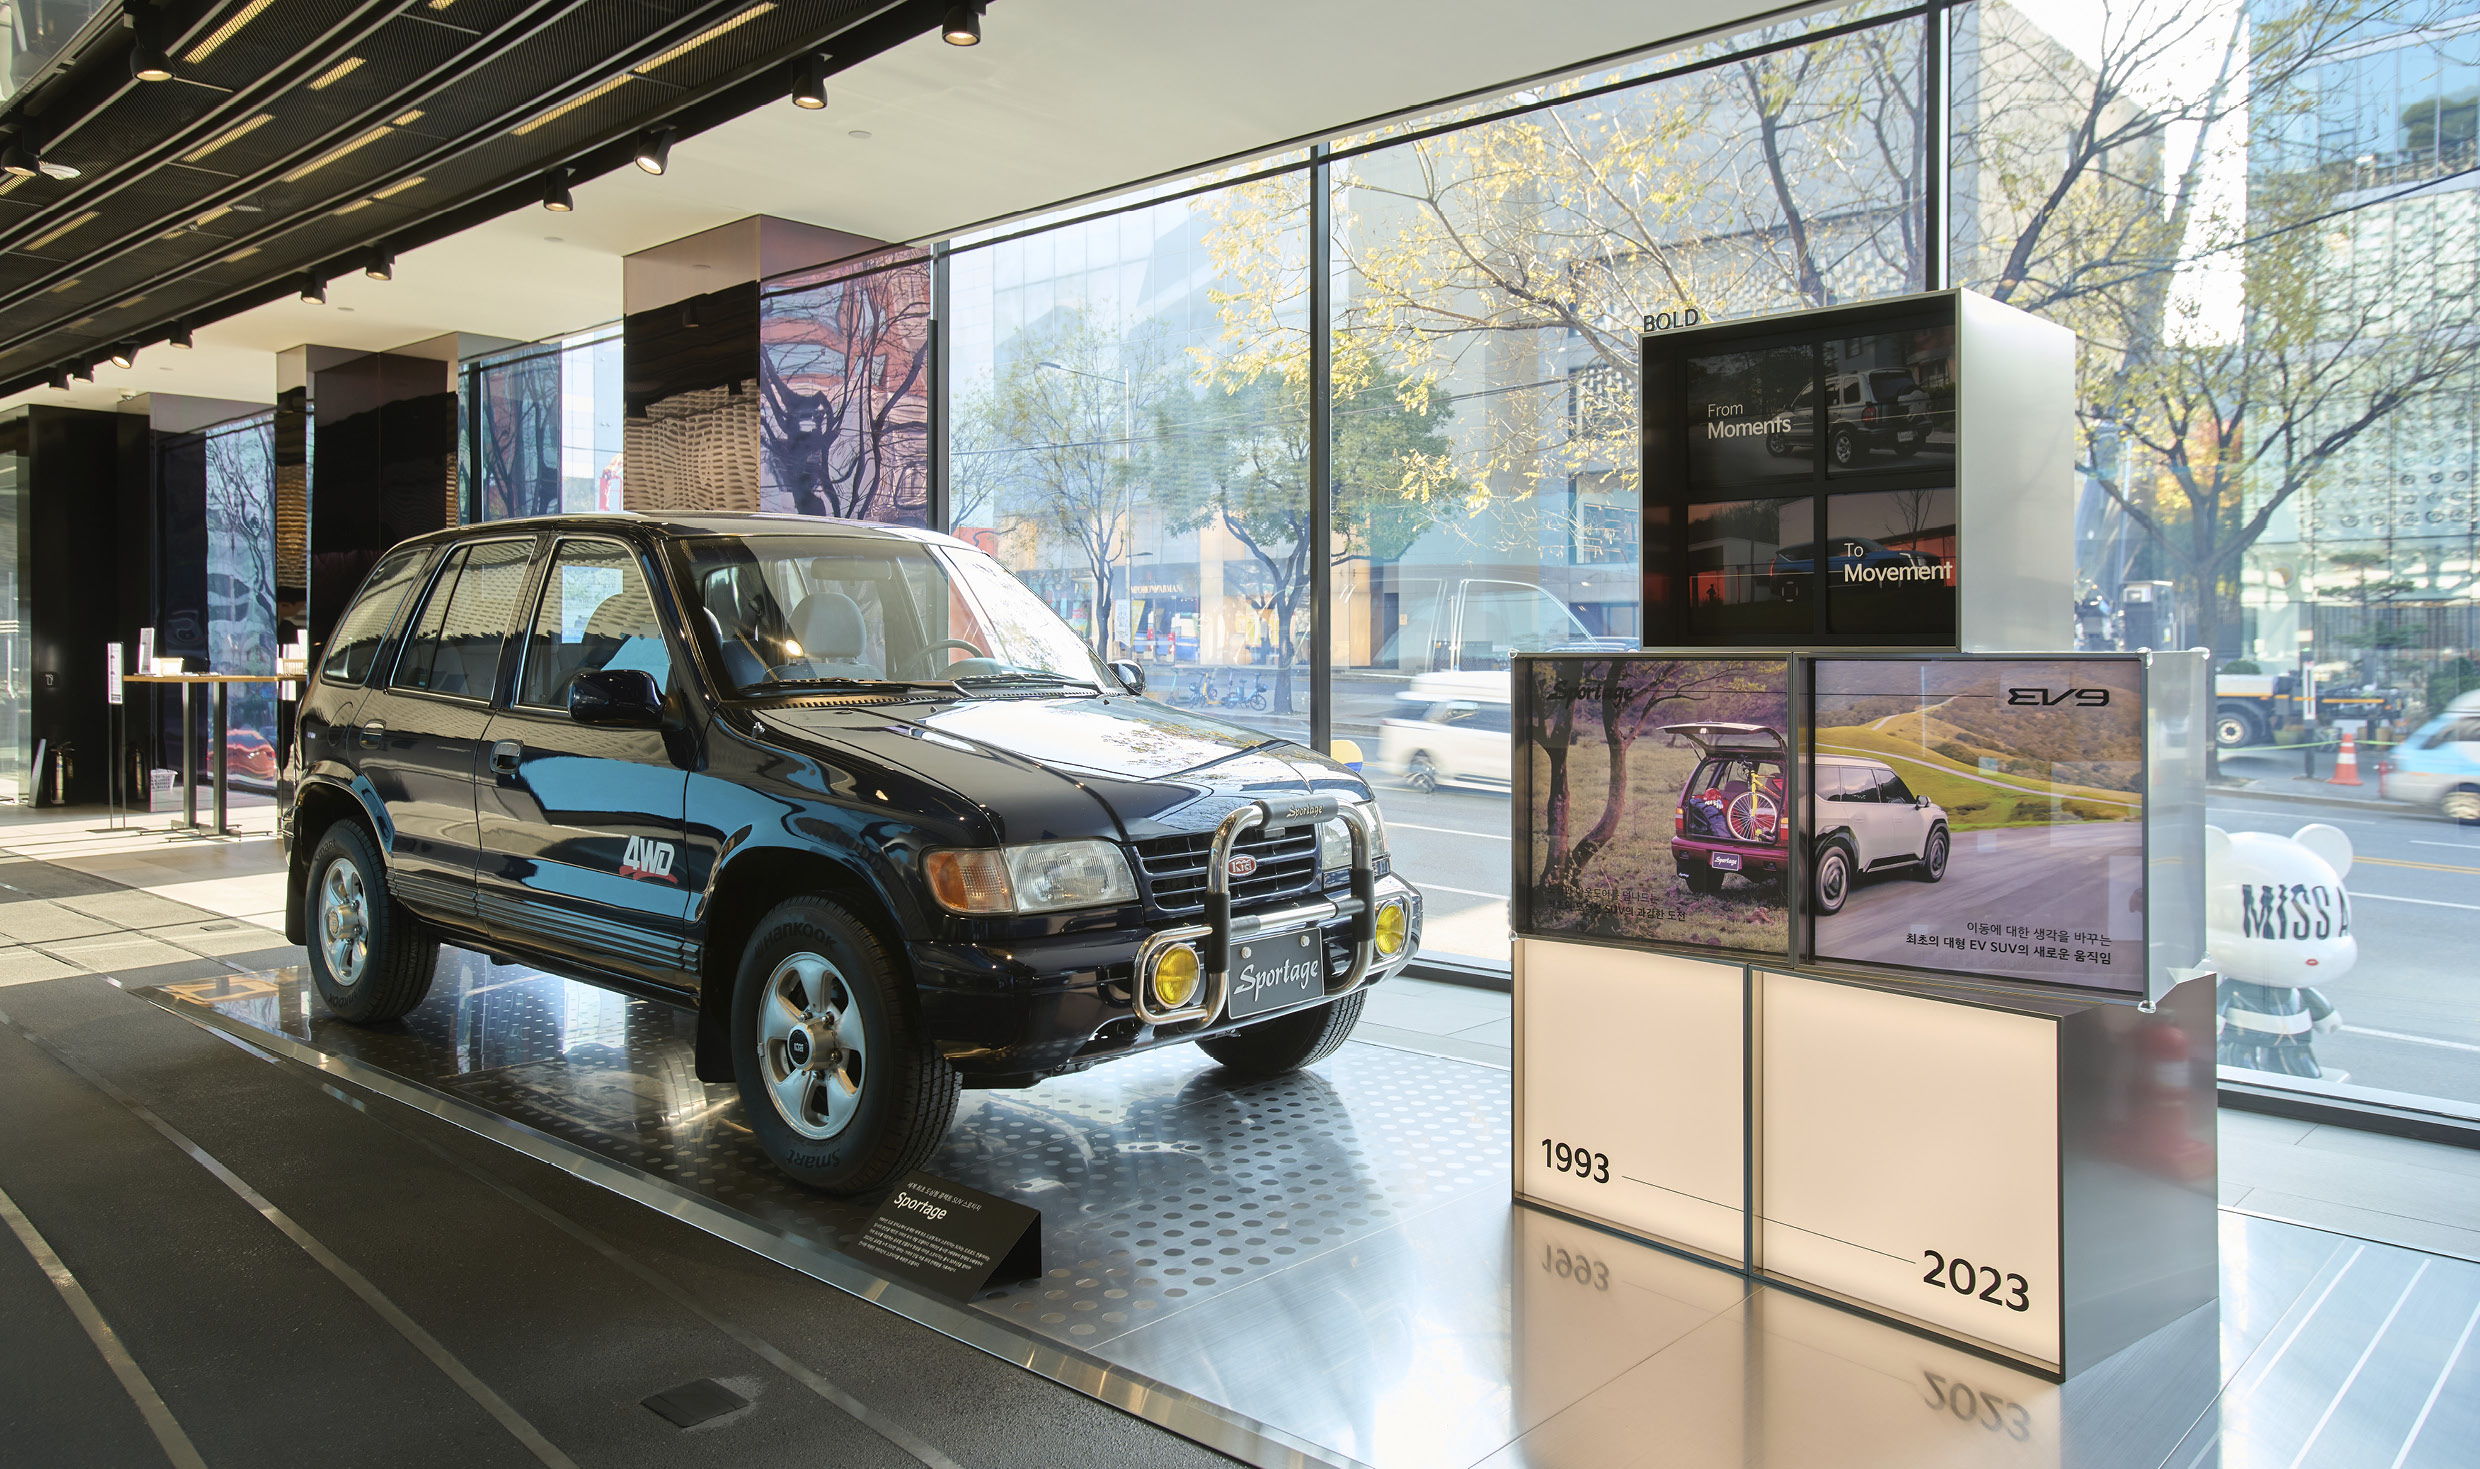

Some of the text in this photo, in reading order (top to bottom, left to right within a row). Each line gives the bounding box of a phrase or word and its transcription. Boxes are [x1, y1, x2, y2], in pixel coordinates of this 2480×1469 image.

[1643, 308, 1699, 332] BOLD
[1707, 403, 1743, 418] From
[1707, 417, 1791, 439] Moments
[1844, 542, 1864, 557] To
[1844, 562, 1953, 582] Movement
[1546, 680, 1634, 709] Sportage
[2007, 687, 2110, 707] EV9
[1287, 804, 1323, 821] Sportage
[623, 835, 675, 876] 4WD
[1604, 904, 1634, 916] SUV의
[1637, 907, 1665, 919] 과감한
[1668, 910, 1686, 921] 도전
[2242, 884, 2330, 940] MISS
[1967, 922, 2112, 947] 이동에 대한 생각을 바꾸는
[1906, 933, 2112, 965] 최초의 대형 EV SUV의 새로운 움직임
[1233, 958, 1319, 1002] Sportage
[1541, 1138, 1611, 1184] 1993
[893, 1191, 948, 1220] Sportage
[1922, 1249, 2030, 1312] 2023
